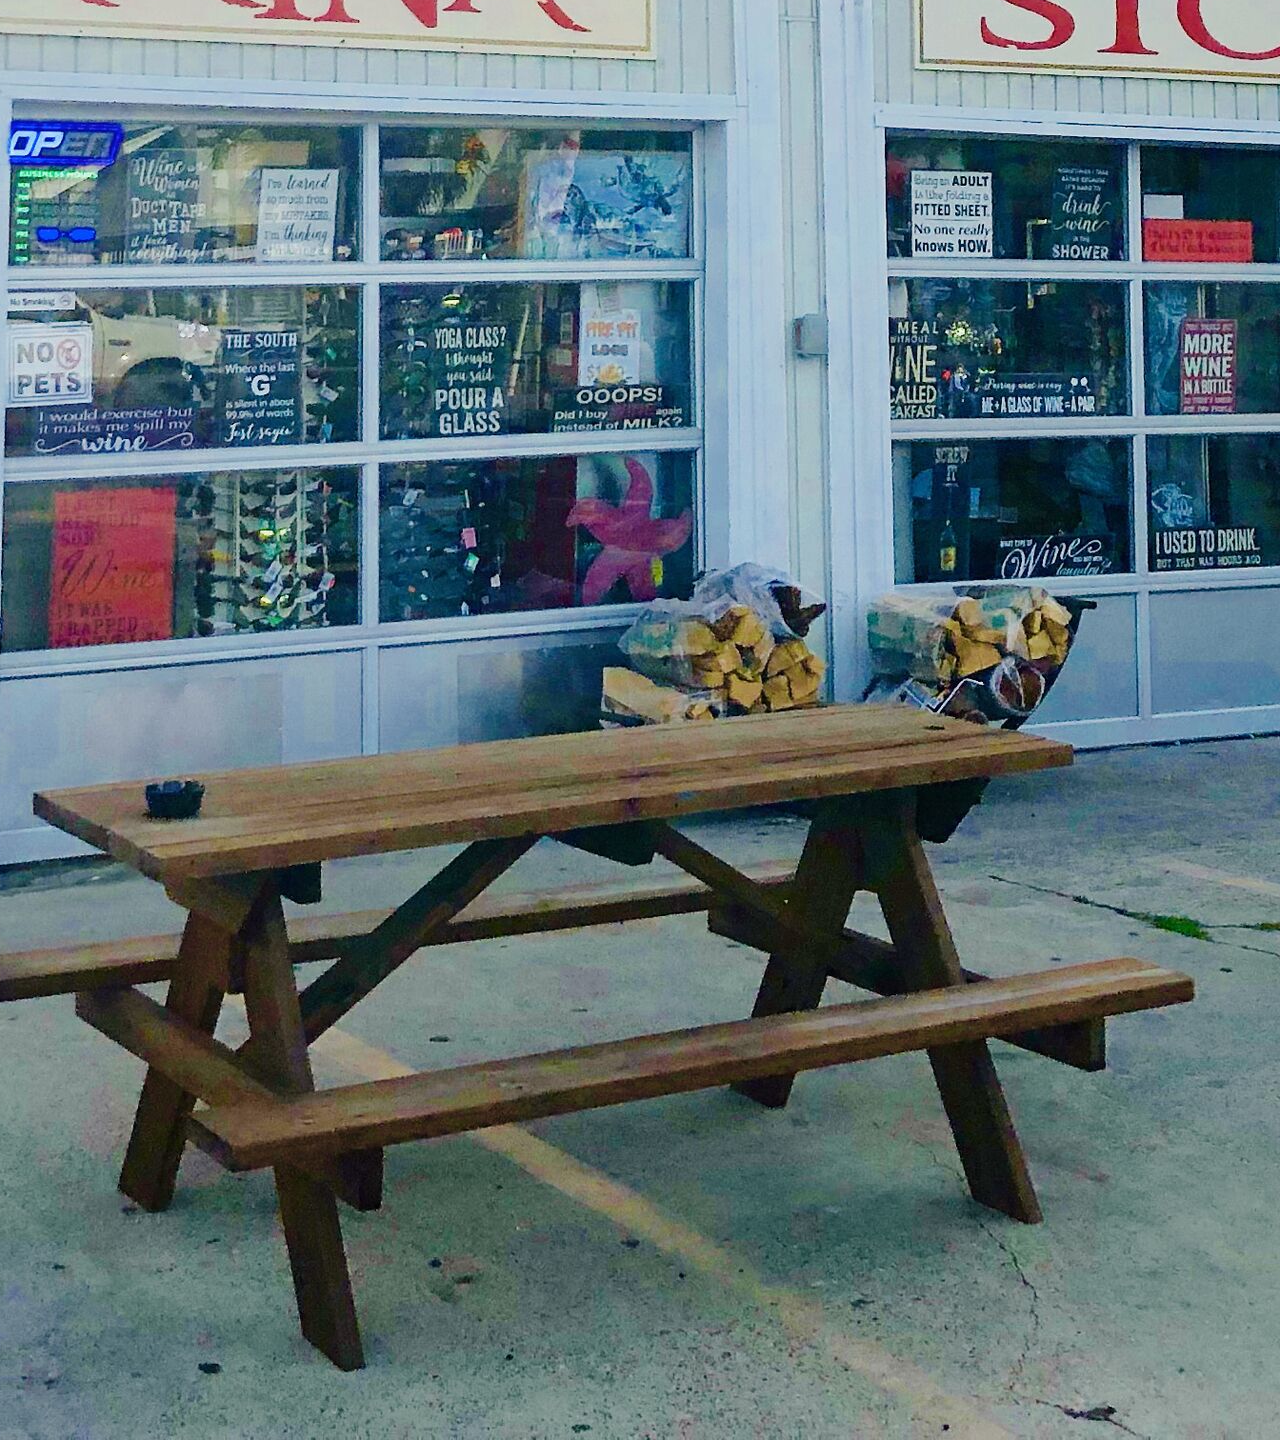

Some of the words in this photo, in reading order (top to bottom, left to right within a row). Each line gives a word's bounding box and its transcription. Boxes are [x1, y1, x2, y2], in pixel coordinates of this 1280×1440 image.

[952, 176, 989, 186] ADULT
[915, 204, 950, 215] FITTED
[1063, 192, 1107, 215] drink
[152, 218, 191, 235] MEN
[914, 224, 930, 234] No
[959, 224, 991, 238] really
[1066, 217, 1106, 233] wine
[915, 239, 954, 252] knows
[958, 239, 990, 252] HOW.
[1052, 244, 1109, 259] SHOWER
[898, 321, 938, 333] MEAL
[226, 334, 251, 348] THE
[255, 333, 297, 347] SOUTH
[435, 328, 462, 349] YOGA
[466, 327, 506, 348] CLASS?
[1184, 333, 1233, 354] MORE
[17, 343, 54, 363] NO
[225, 364, 257, 374] Where
[260, 363, 277, 372] the
[278, 362, 295, 371] last
[1184, 357, 1232, 377] WINE
[18, 373, 81, 394] PETS
[447, 372, 465, 387] you
[470, 368, 494, 383] said
[1184, 380, 1192, 394] IN
[1194, 380, 1200, 393] A
[1202, 380, 1232, 393] BOTTLE
[269, 398, 295, 406] about
[436, 388, 486, 410] POUR
[492, 387, 504, 407] A
[576, 387, 662, 404] OOOPS!
[1008, 397, 1031, 412] GLASS
[1033, 397, 1042, 412] OF
[1044, 396, 1064, 412] WINE
[39, 412, 43, 422] I
[50, 409, 97, 422] would
[102, 409, 163, 419] exercise
[168, 407, 194, 417] but
[255, 409, 265, 417] of
[266, 408, 294, 417] words
[555, 410, 575, 420] Did
[586, 410, 608, 420] buy
[39, 424, 47, 434] it
[53, 422, 100, 433] makes
[134, 419, 163, 433] spill
[168, 420, 191, 430] my
[440, 411, 500, 434] GLASS
[623, 417, 682, 429] MILK?
[82, 433, 148, 451] wine
[1156, 532, 1160, 554] I
[1164, 531, 1196, 554] USED
[1199, 530, 1214, 552] TO
[1001, 535, 1102, 579] Wine
